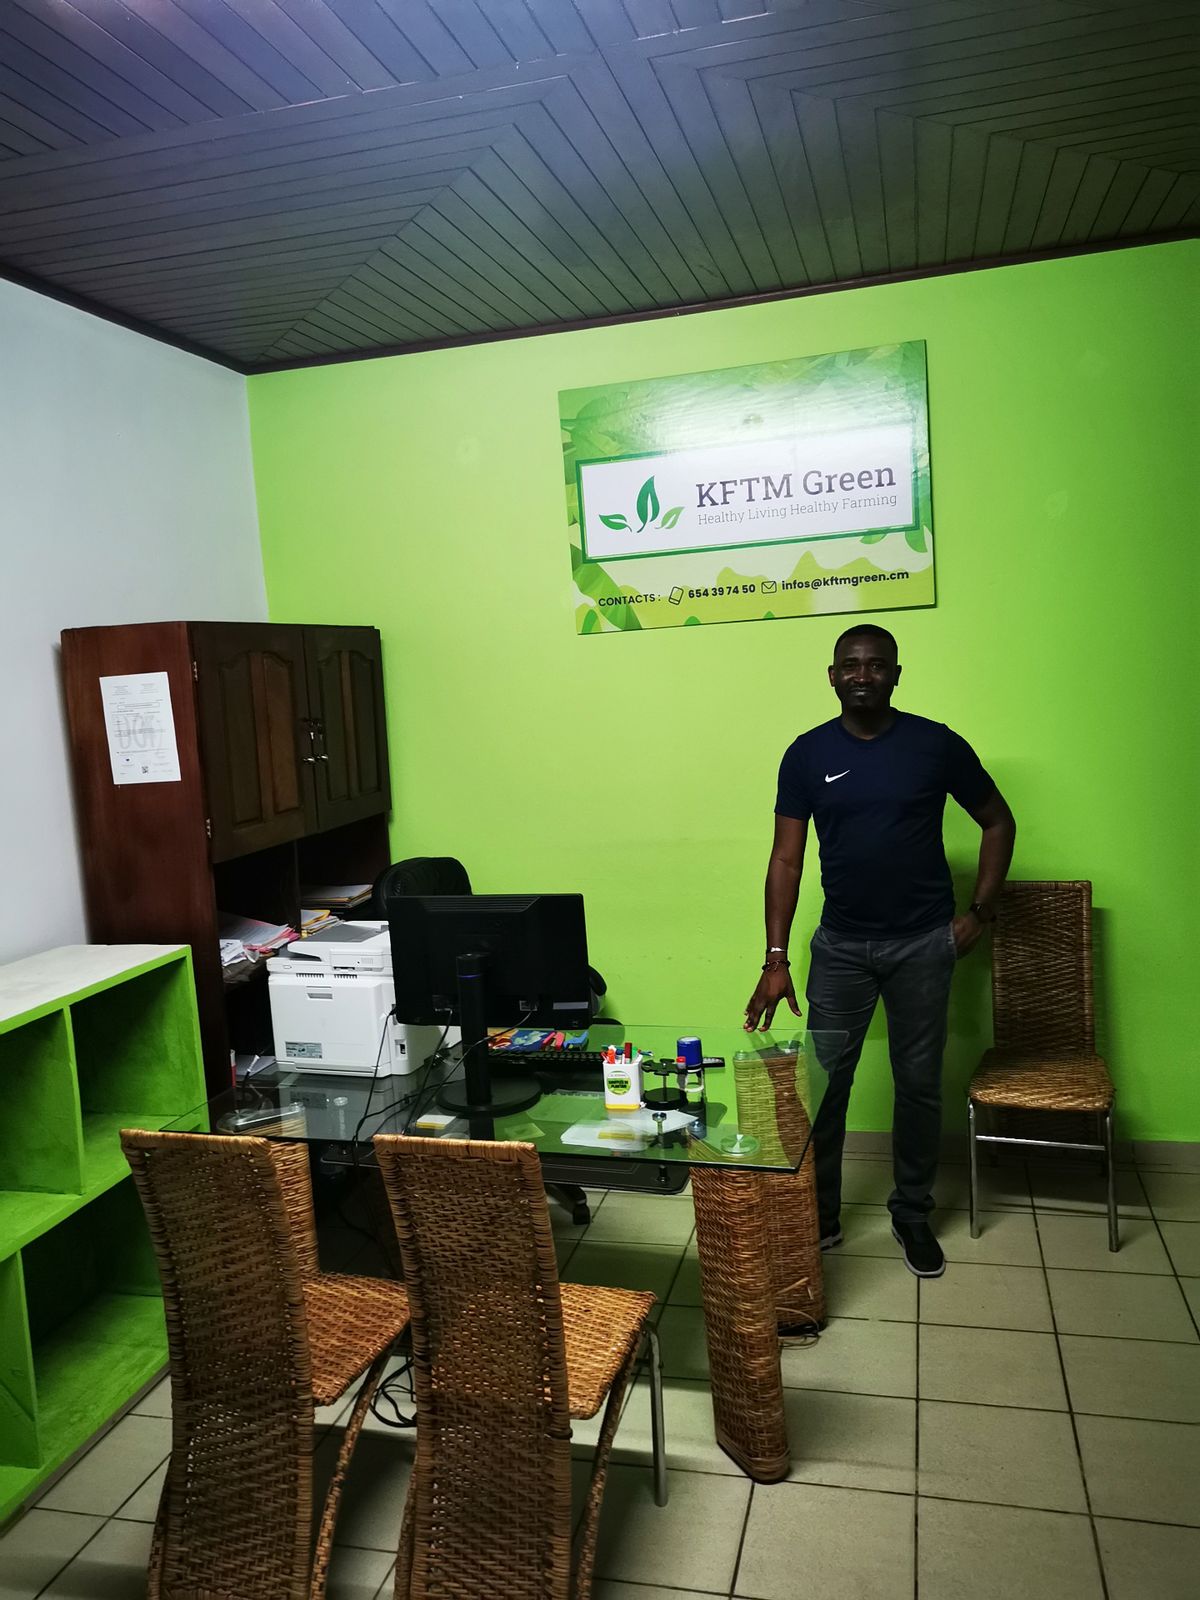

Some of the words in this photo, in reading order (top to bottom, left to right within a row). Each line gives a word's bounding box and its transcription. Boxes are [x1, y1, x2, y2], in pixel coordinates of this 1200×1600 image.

[696, 473, 793, 508] KFTM
[802, 466, 897, 496] Green
[697, 510, 745, 526] Healthy
[748, 505, 787, 521] Living
[790, 500, 838, 516] Healthy
[842, 494, 897, 511] Farming
[598, 593, 656, 607] CONTACTS
[688, 587, 709, 599] 654
[711, 586, 724, 597] 39
[727, 585, 740, 596] 74
[742, 583, 756, 594] 50
[781, 570, 910, 591] infos@kftmgreen.cm
